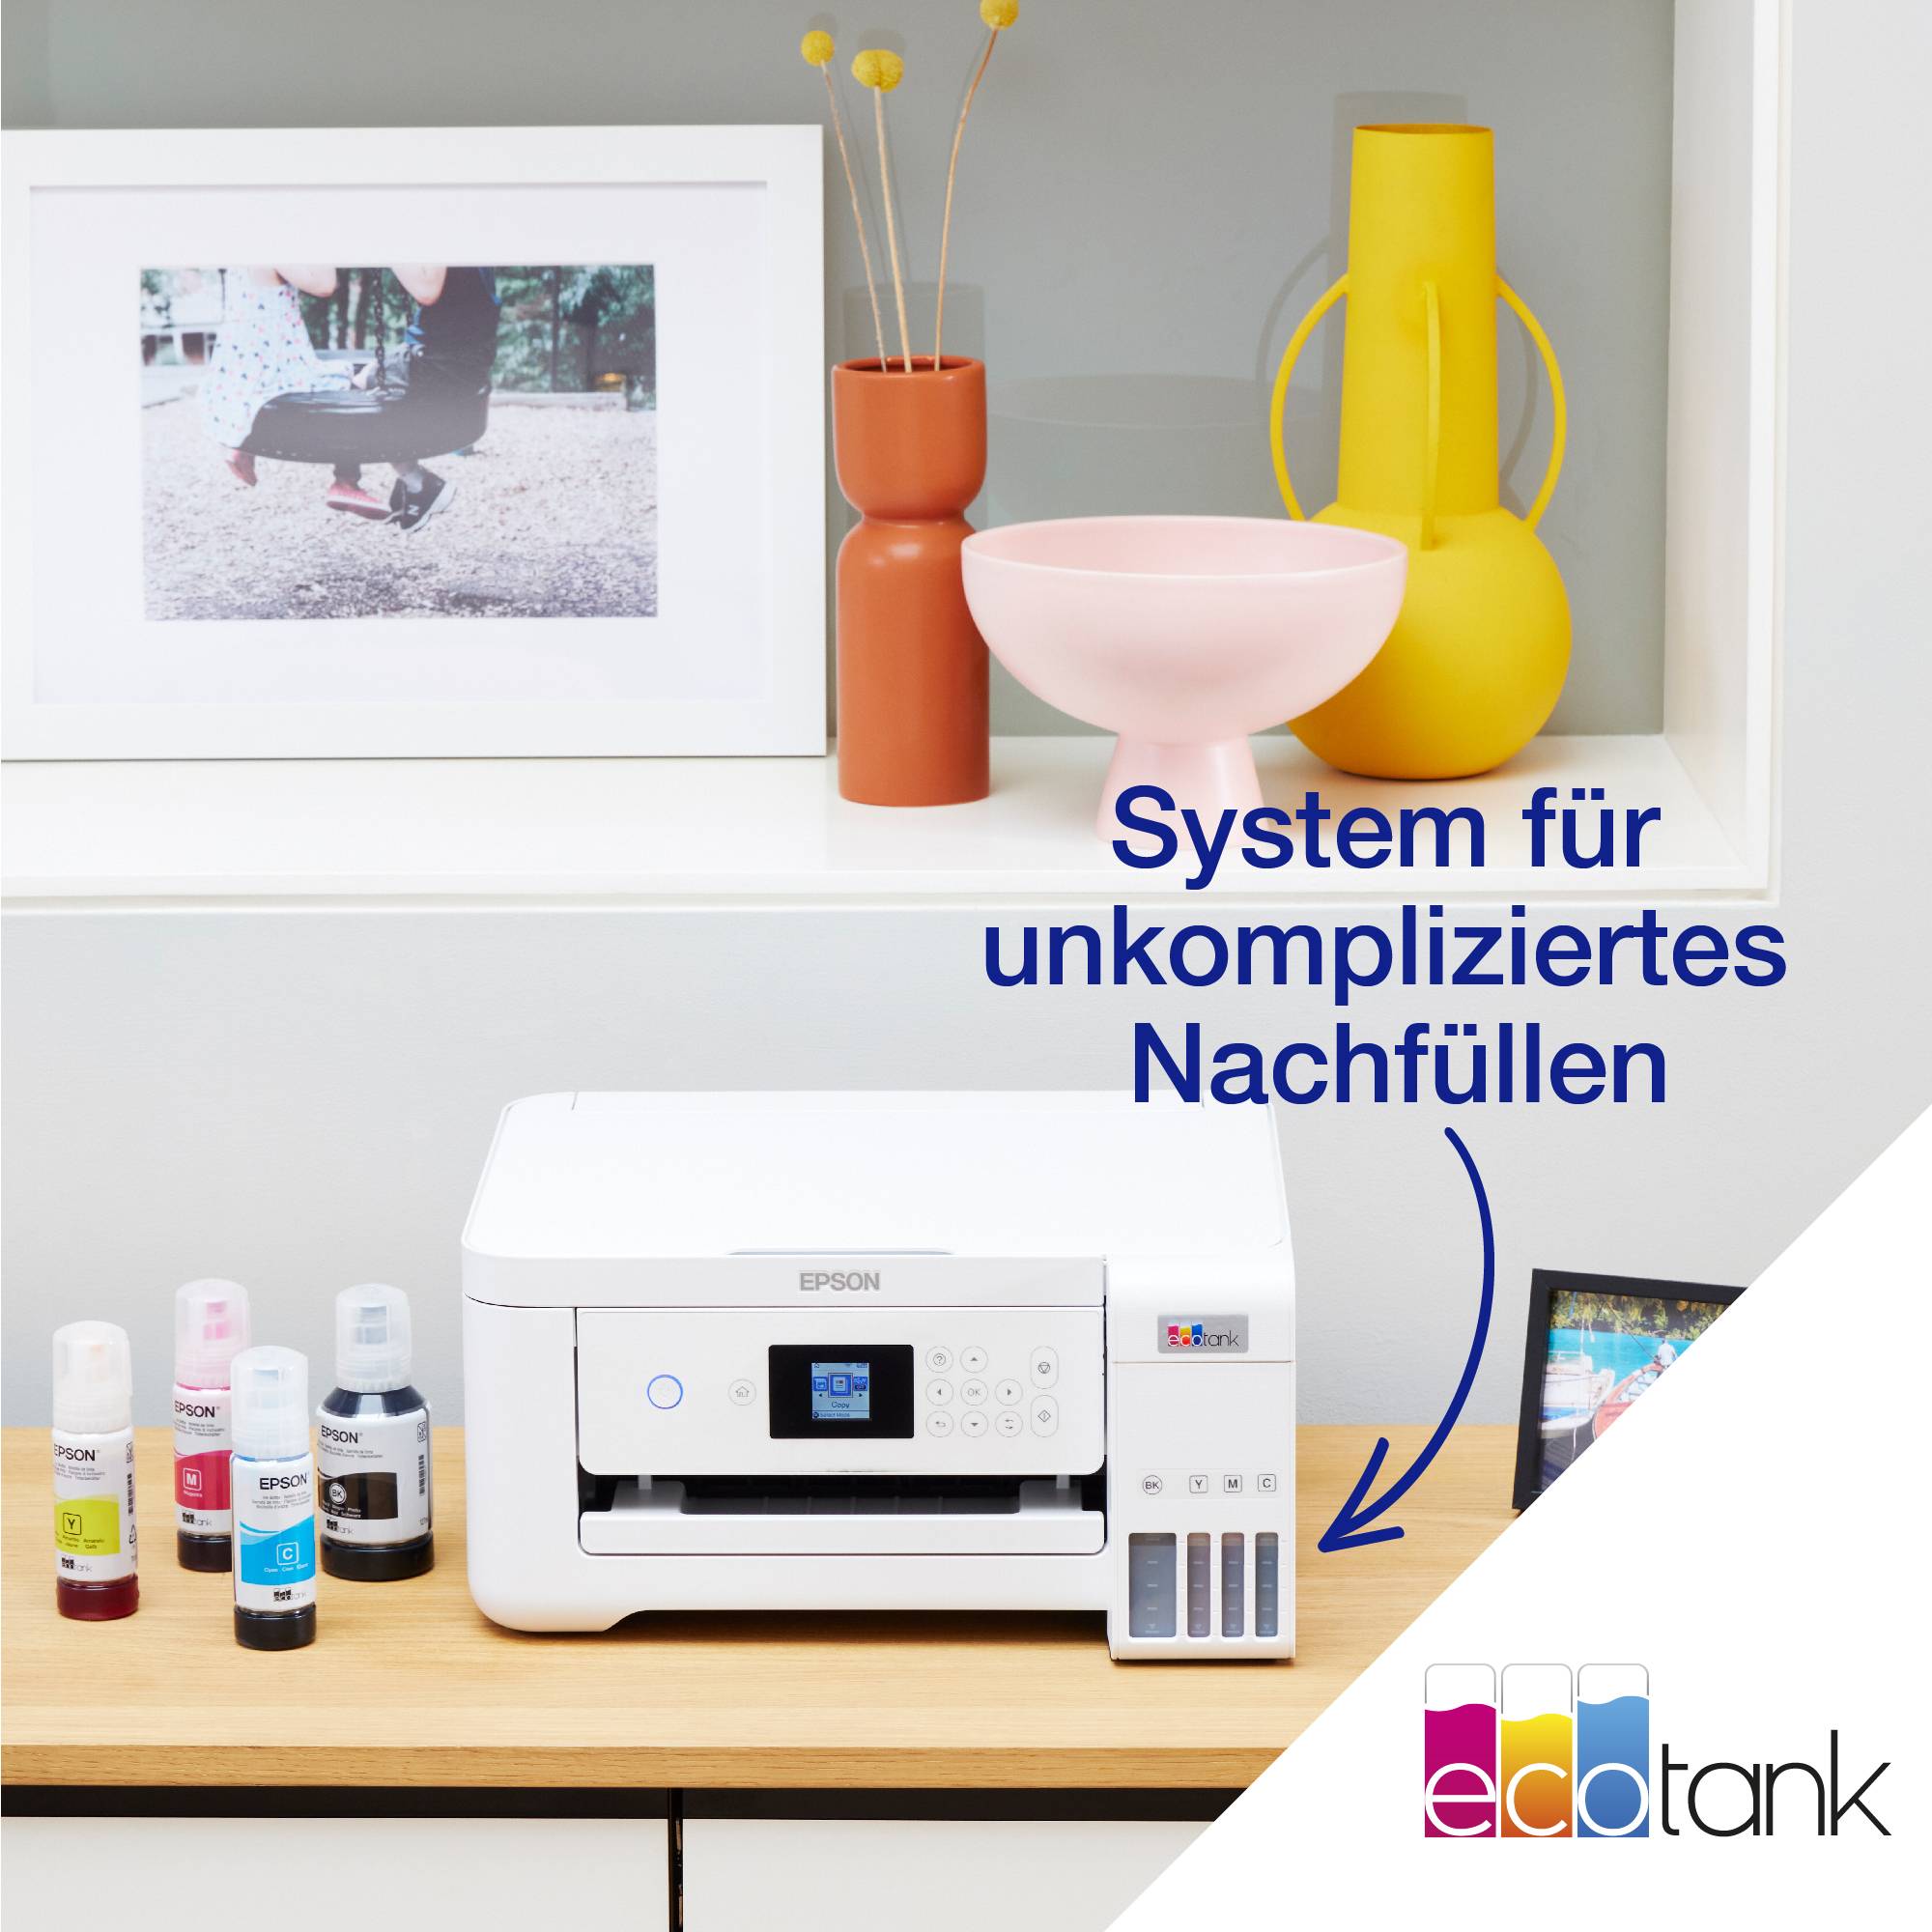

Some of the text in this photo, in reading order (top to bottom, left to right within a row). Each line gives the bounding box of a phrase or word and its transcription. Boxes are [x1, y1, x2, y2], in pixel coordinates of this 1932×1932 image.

[800, 1272, 880, 1292] EPSON
[1167, 1329, 1239, 1348] ecotank
[967, 1387, 980, 1397] OK
[175, 1401, 215, 1418] EPSON
[831, 1401, 850, 1409] Copy
[321, 1425, 359, 1444] EPSON
[54, 1443, 96, 1461] EPSON
[186, 1473, 197, 1486] M
[260, 1472, 308, 1491] EPSON
[1145, 1480, 1159, 1491] BK
[1228, 1479, 1238, 1489] M
[1263, 1478, 1272, 1489] C
[331, 1489, 343, 1498] BK
[68, 1519, 76, 1529] Y
[282, 1548, 294, 1560] C
